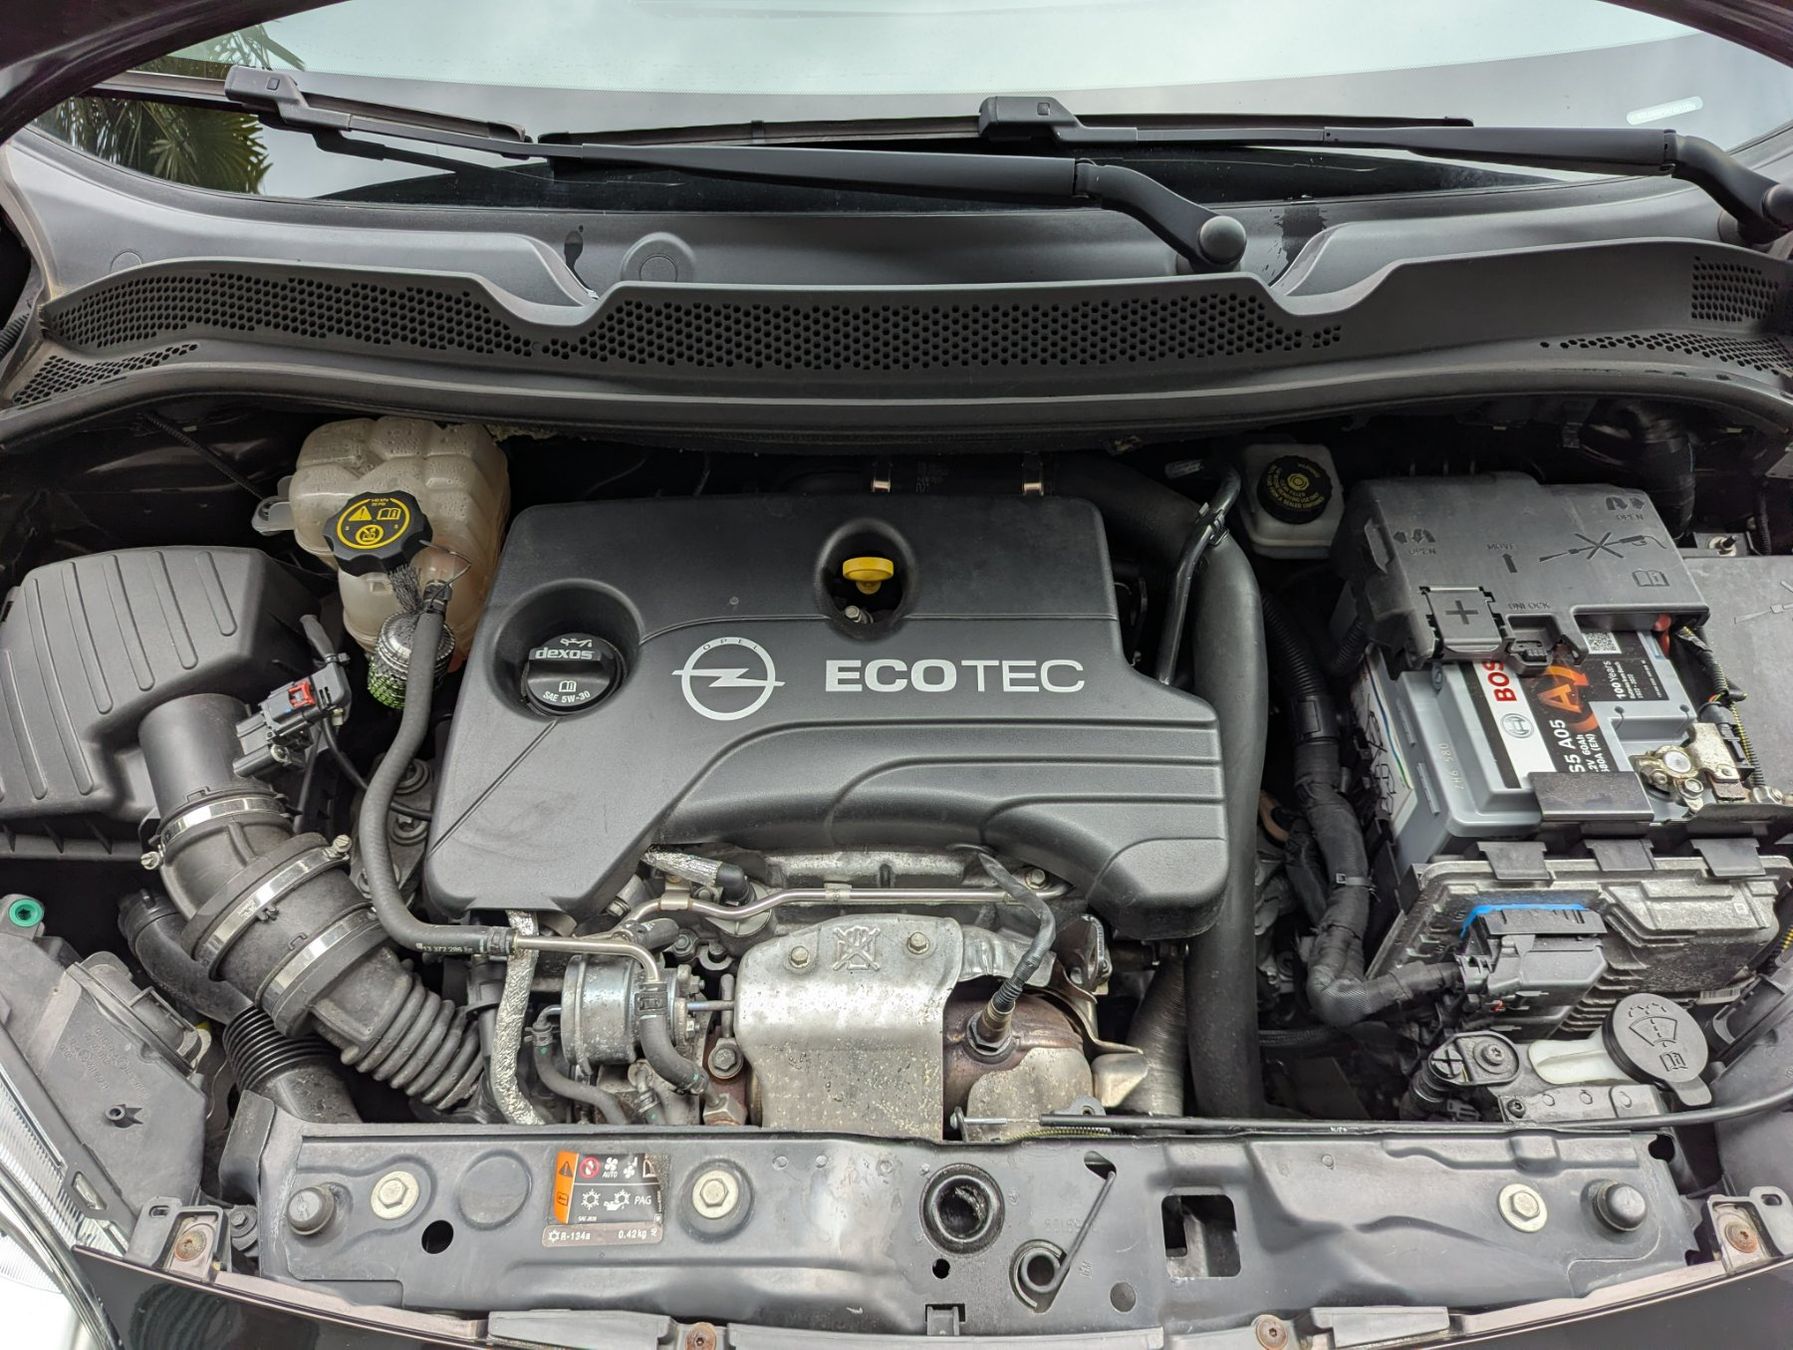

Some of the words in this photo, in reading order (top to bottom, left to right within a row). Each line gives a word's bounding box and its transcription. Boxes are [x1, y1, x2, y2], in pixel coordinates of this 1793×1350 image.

[535, 647, 595, 659] dexos
[702, 638, 760, 651] OPEL
[825, 659, 1085, 693] ECOTEC
[1482, 661, 1517, 701] BOS
[543, 691, 560, 702] SAE
[561, 690, 591, 703] 5W-30
[1549, 720, 1576, 749] A05
[1586, 733, 1601, 750] (EN)
[1576, 734, 1591, 755] 60Ah
[1563, 754, 1586, 772] S5
[1585, 759, 1600, 772] 2V
[634, 1195, 652, 1205] PAG
